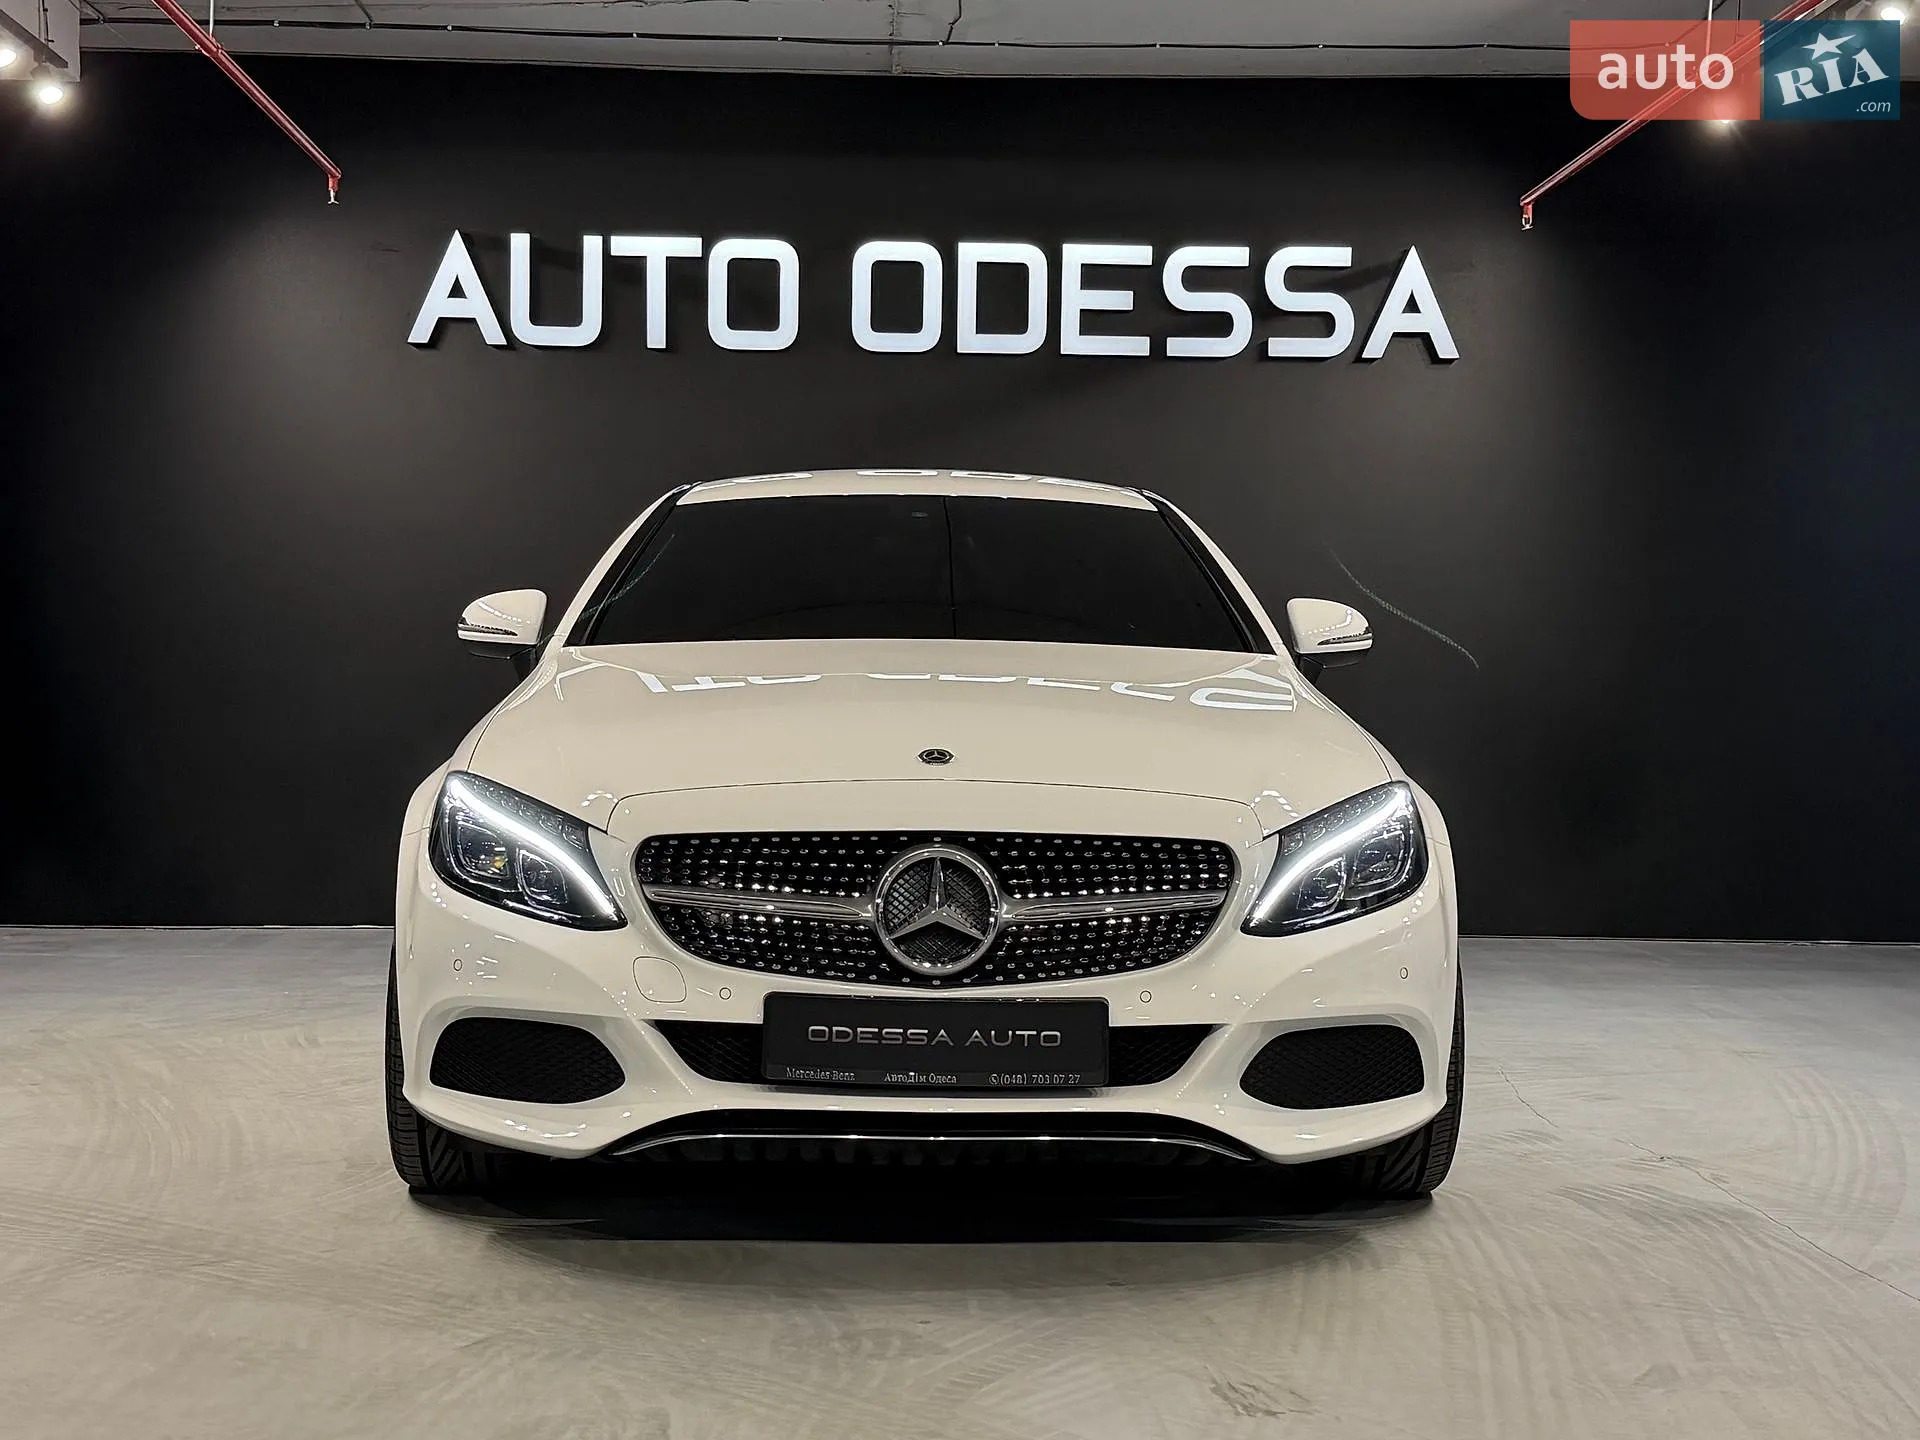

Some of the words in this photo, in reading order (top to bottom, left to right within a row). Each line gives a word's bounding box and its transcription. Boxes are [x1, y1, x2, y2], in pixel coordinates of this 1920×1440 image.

[407, 229, 800, 351] AUTO
[851, 240, 1460, 360] ODESSA
[808, 1025, 954, 1046] ODESSA
[964, 1029, 1061, 1047] AUTO
[1031, 1074, 1050, 1085] 703
[1053, 1074, 1065, 1085] 07
[1068, 1074, 1081, 1085] 27
